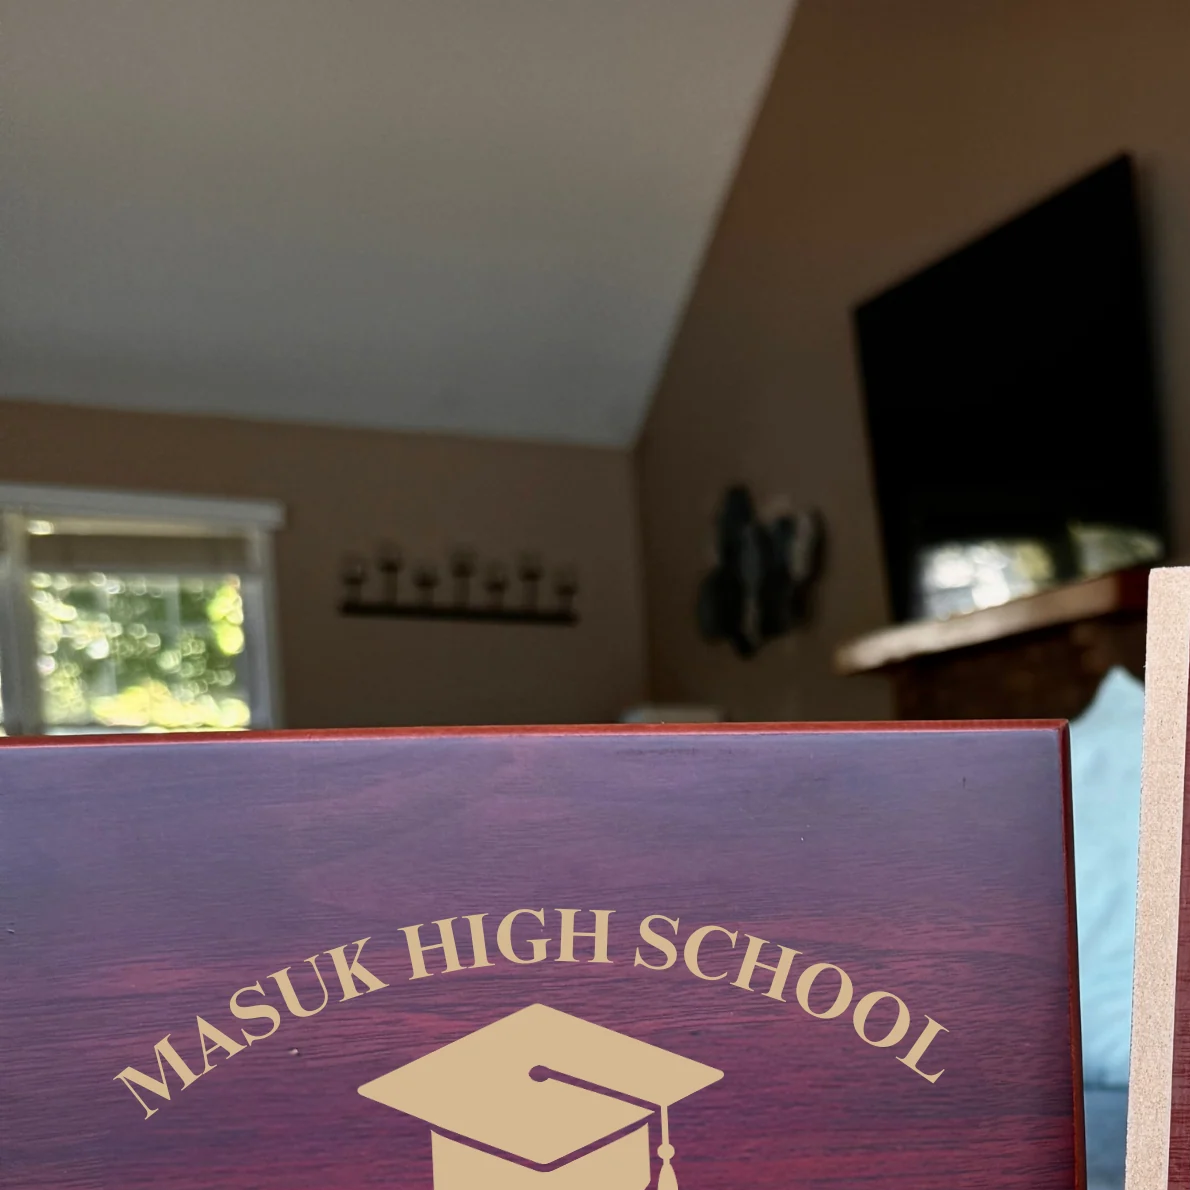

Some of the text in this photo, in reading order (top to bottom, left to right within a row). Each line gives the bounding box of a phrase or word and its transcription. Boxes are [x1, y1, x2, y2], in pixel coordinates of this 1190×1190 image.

[113, 908, 949, 1119] MASUK HIGH SCHOOL
